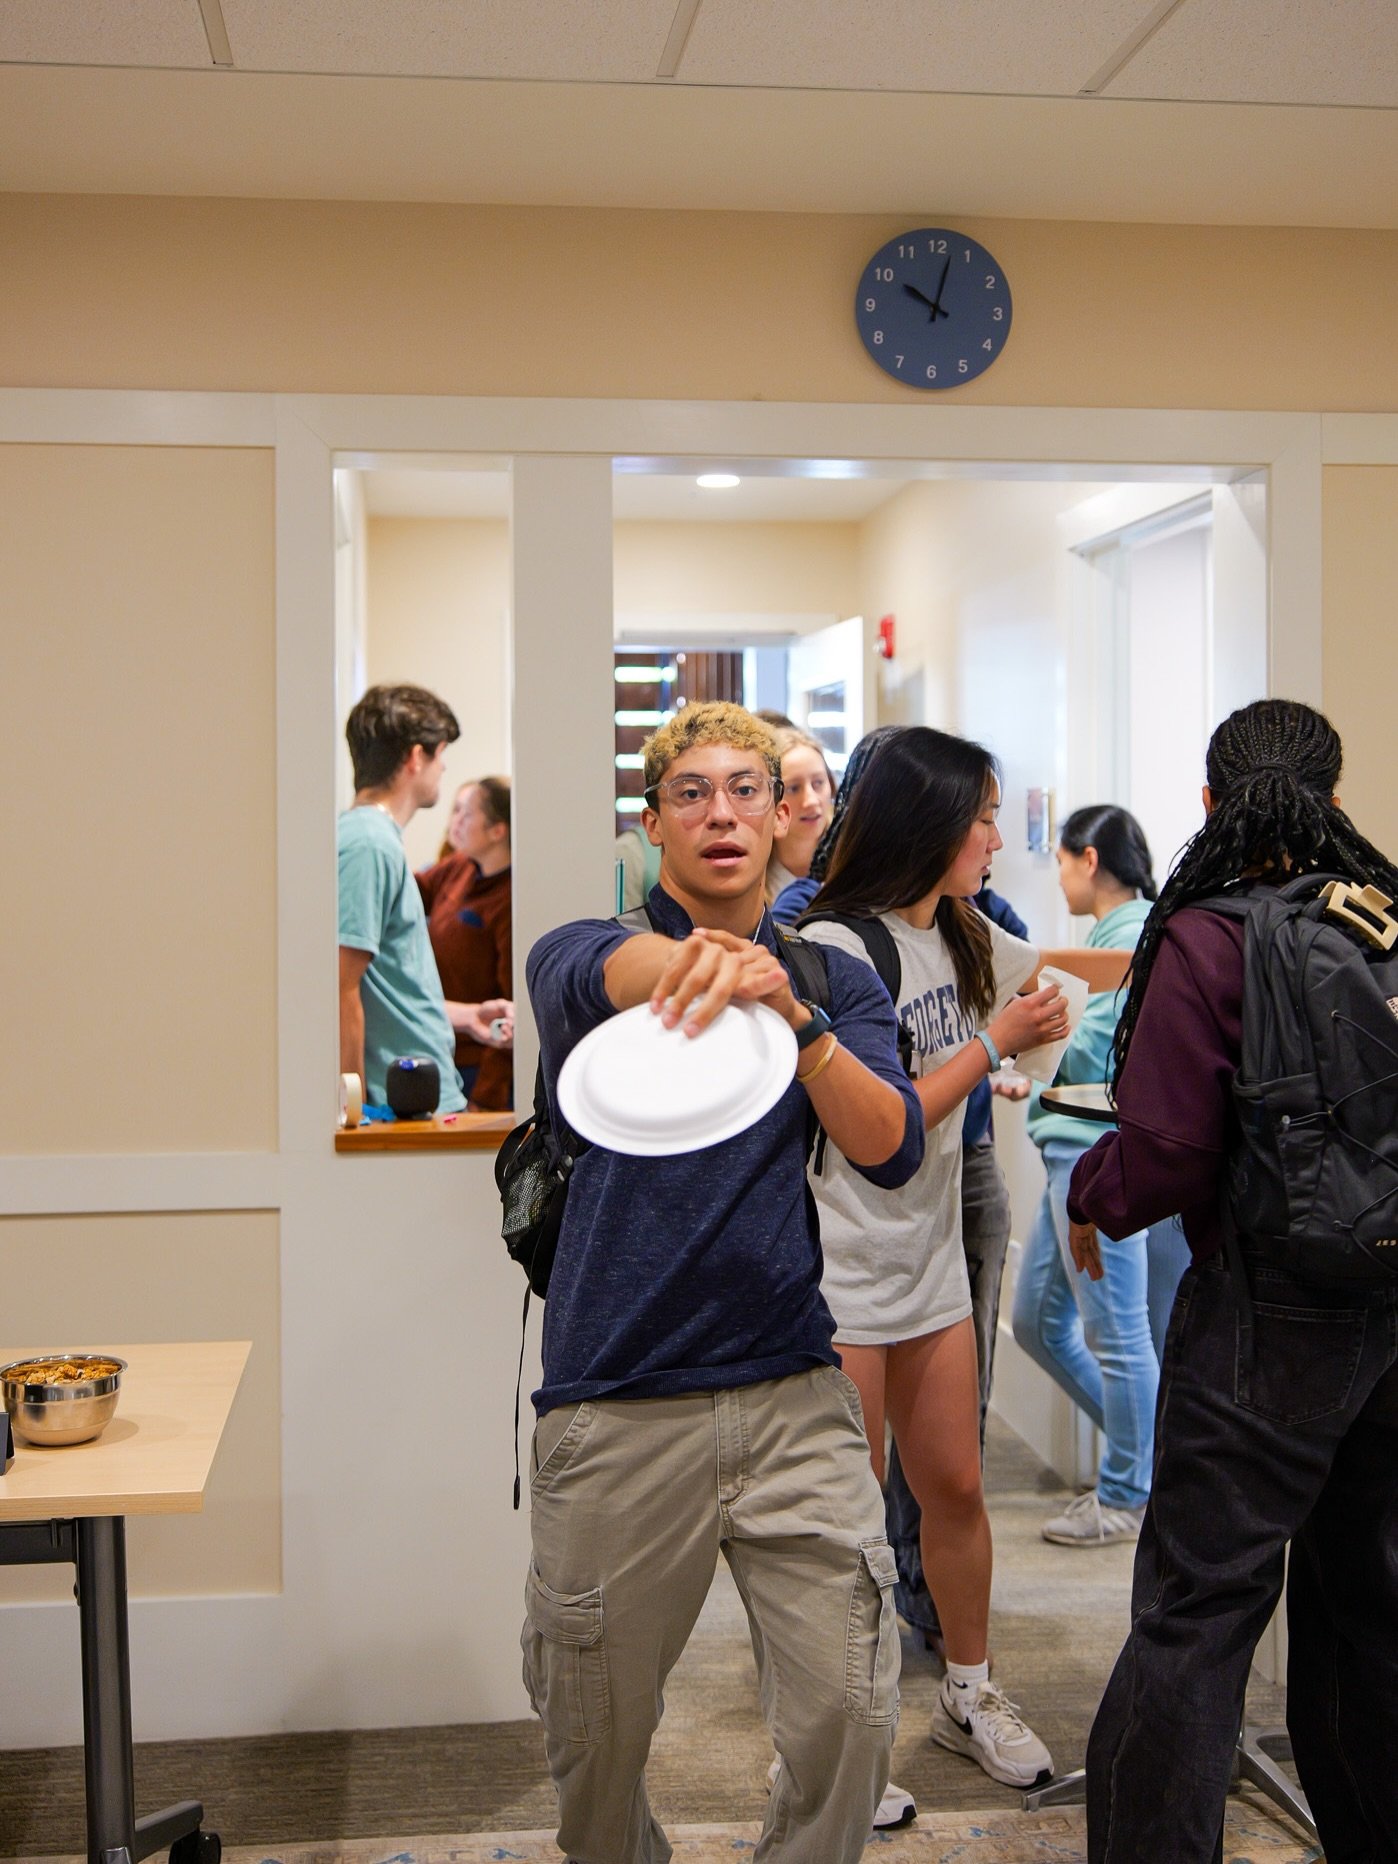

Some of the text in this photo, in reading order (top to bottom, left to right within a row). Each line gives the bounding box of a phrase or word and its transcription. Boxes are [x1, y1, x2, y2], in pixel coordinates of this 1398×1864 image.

[898, 245, 915, 259] 11
[929, 239, 948, 254] 12
[964, 250, 971, 263] 1
[875, 267, 894, 282] 10
[985, 275, 996, 289] 2
[865, 298, 876, 312] 9
[993, 307, 1003, 321] 3
[873, 330, 884, 345] 8
[982, 338, 993, 352] 4
[895, 355, 905, 369] 7
[958, 359, 968, 373] 5
[926, 364, 937, 379] 6
